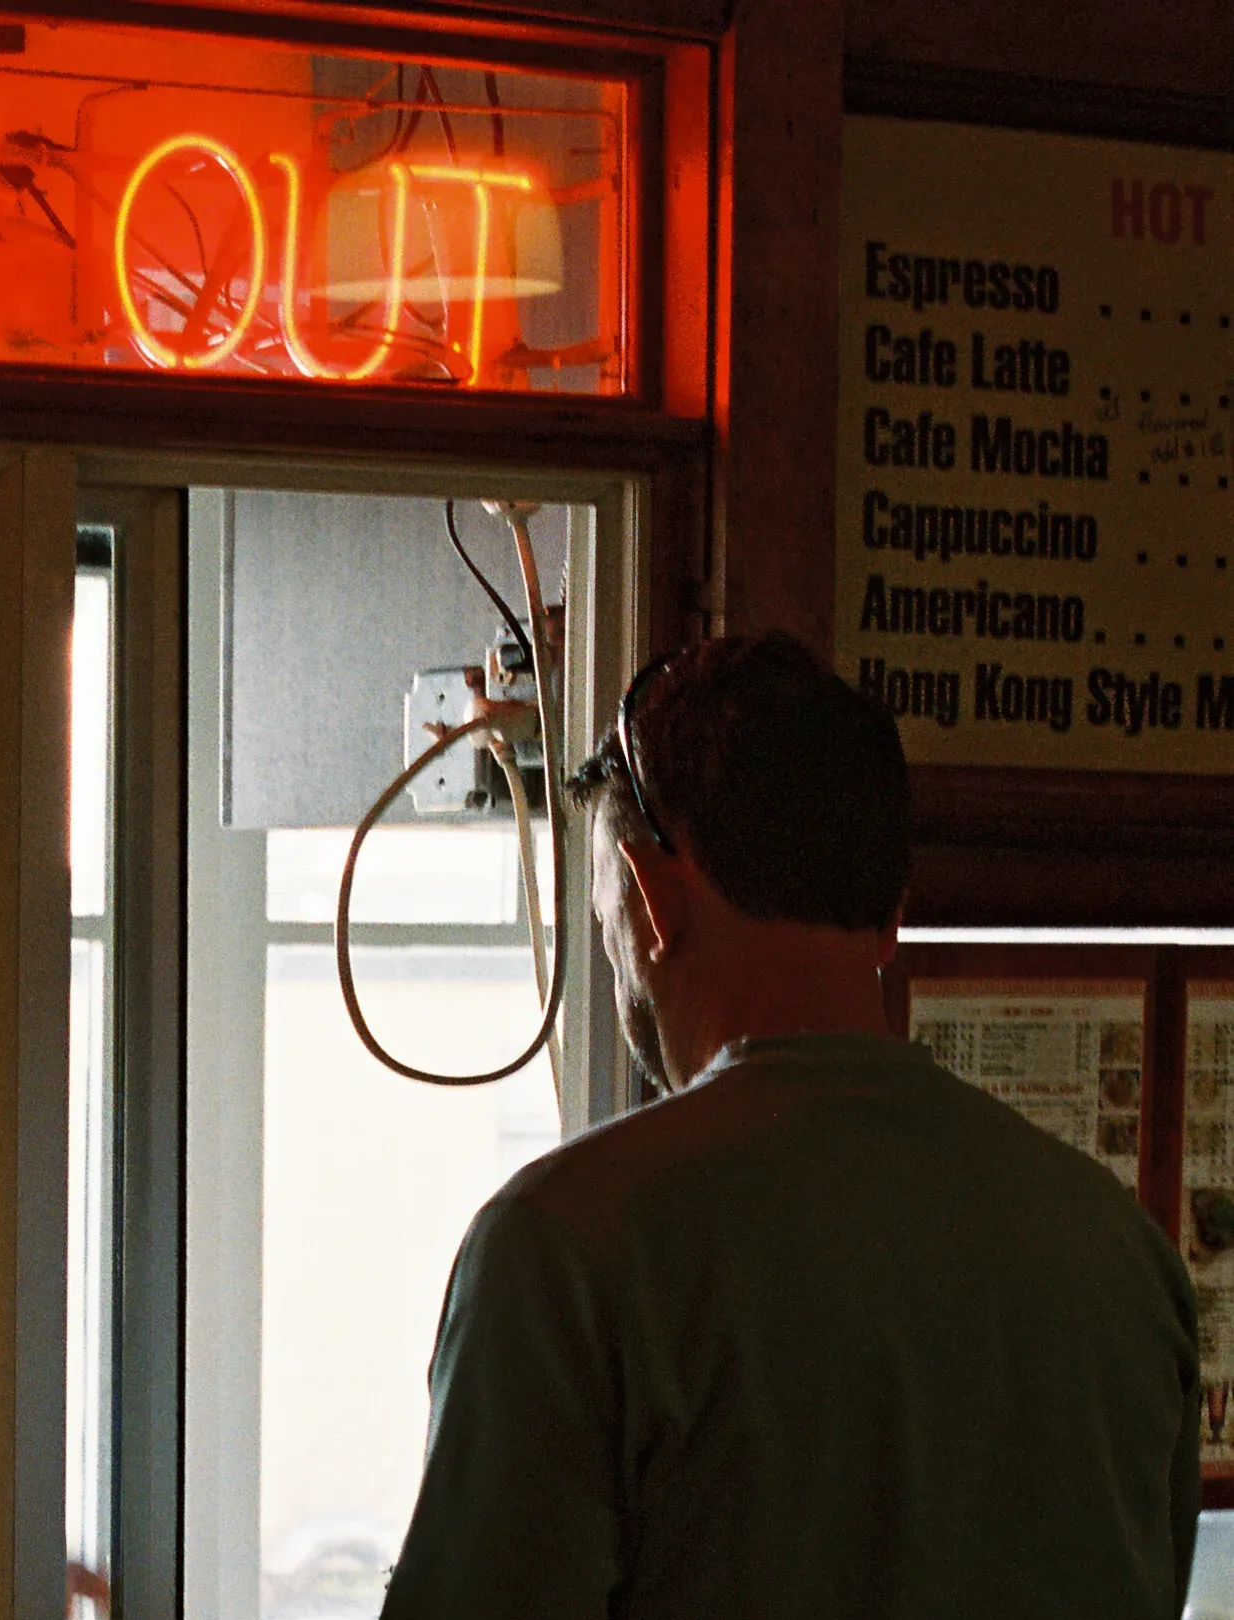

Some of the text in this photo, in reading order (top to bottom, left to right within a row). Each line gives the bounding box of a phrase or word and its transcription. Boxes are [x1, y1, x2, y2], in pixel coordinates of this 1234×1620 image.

[1111, 176, 1214, 247] HOT
[112, 132, 534, 388] OUT
[866, 240, 1059, 314] Espresso
[866, 324, 1070, 396] Cafe Latte
[865, 406, 955, 470] Cafe
[970, 413, 1108, 481] Mocha
[864, 488, 1098, 563] Cappuccino
[861, 573, 1084, 643] Americano
[859, 657, 961, 728] Hong
[974, 662, 1073, 732] Kong
[1086, 667, 1182, 736] Style
